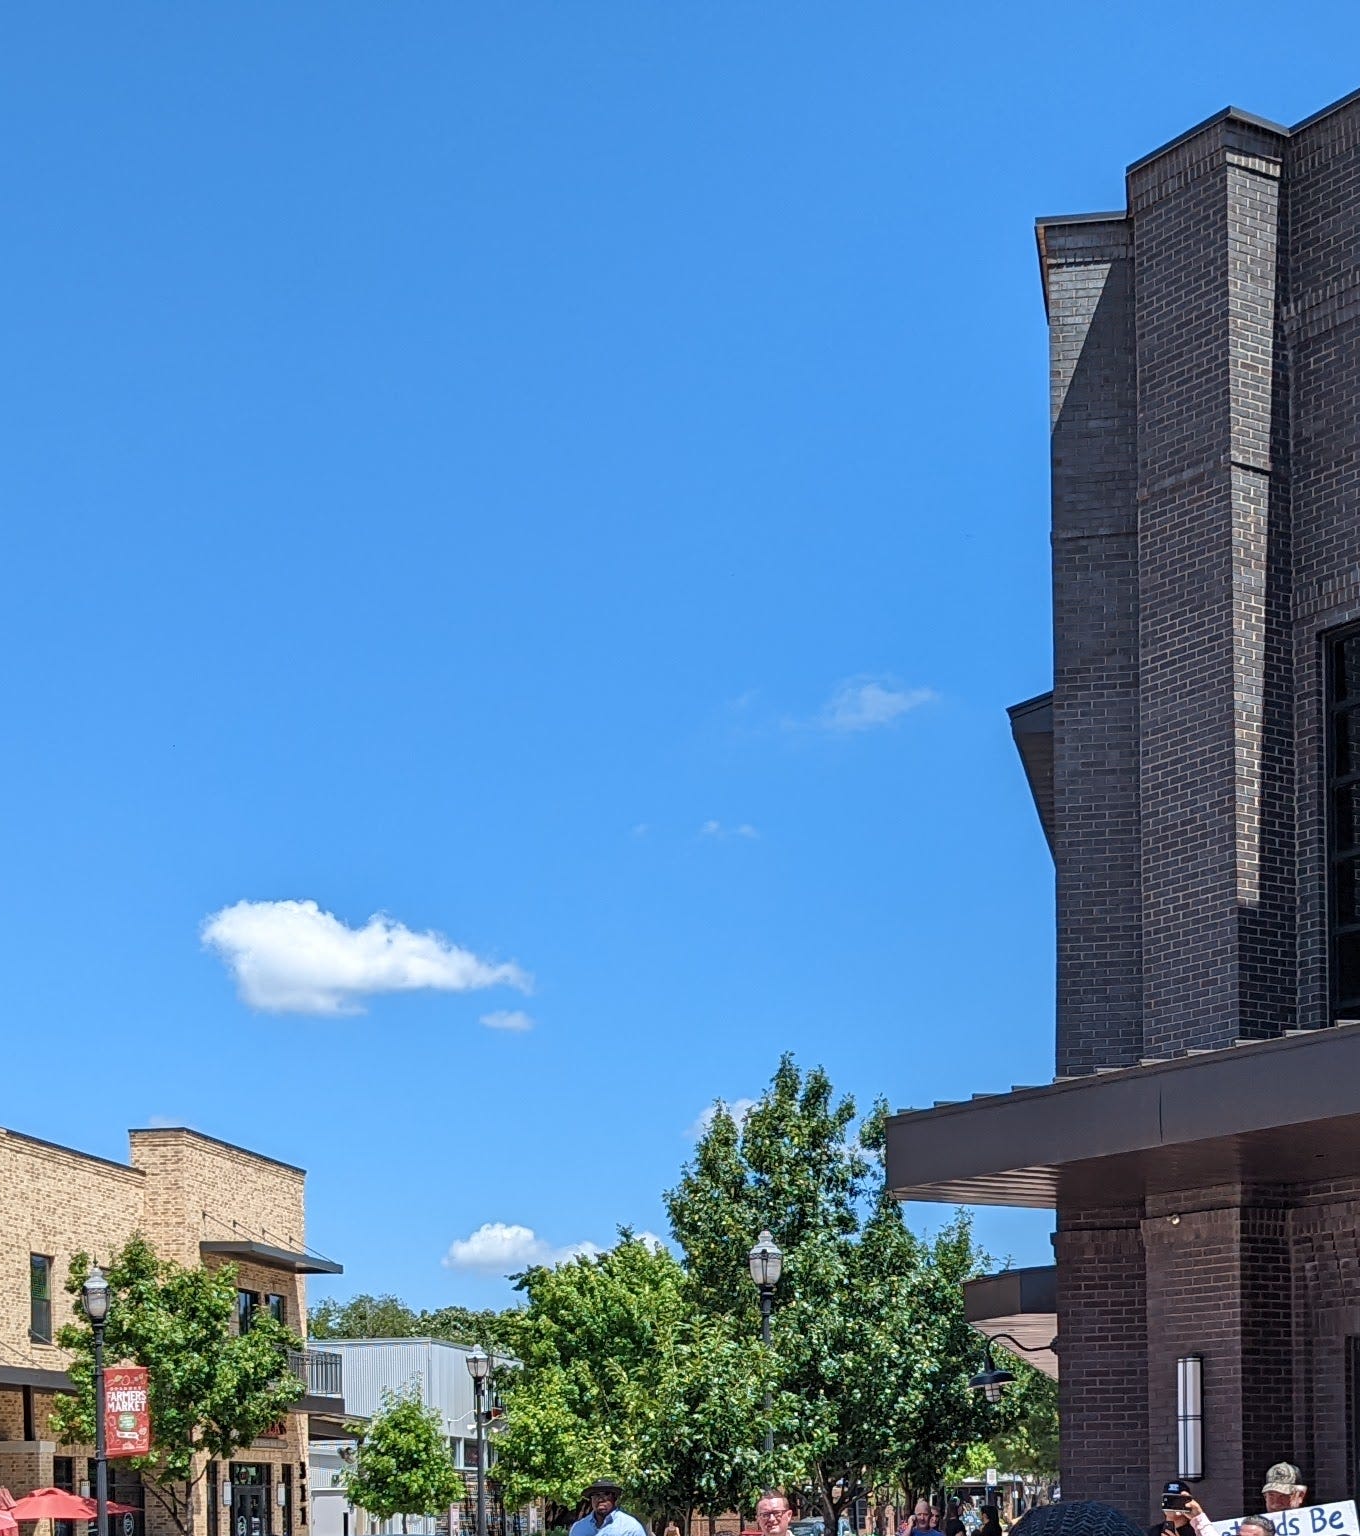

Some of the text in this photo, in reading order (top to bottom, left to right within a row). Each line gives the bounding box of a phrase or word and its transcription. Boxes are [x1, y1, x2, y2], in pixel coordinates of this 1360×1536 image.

[106, 1390, 147, 1402] FARMERS
[106, 1400, 147, 1413] MARKET
[1310, 1507, 1345, 1534] Be
